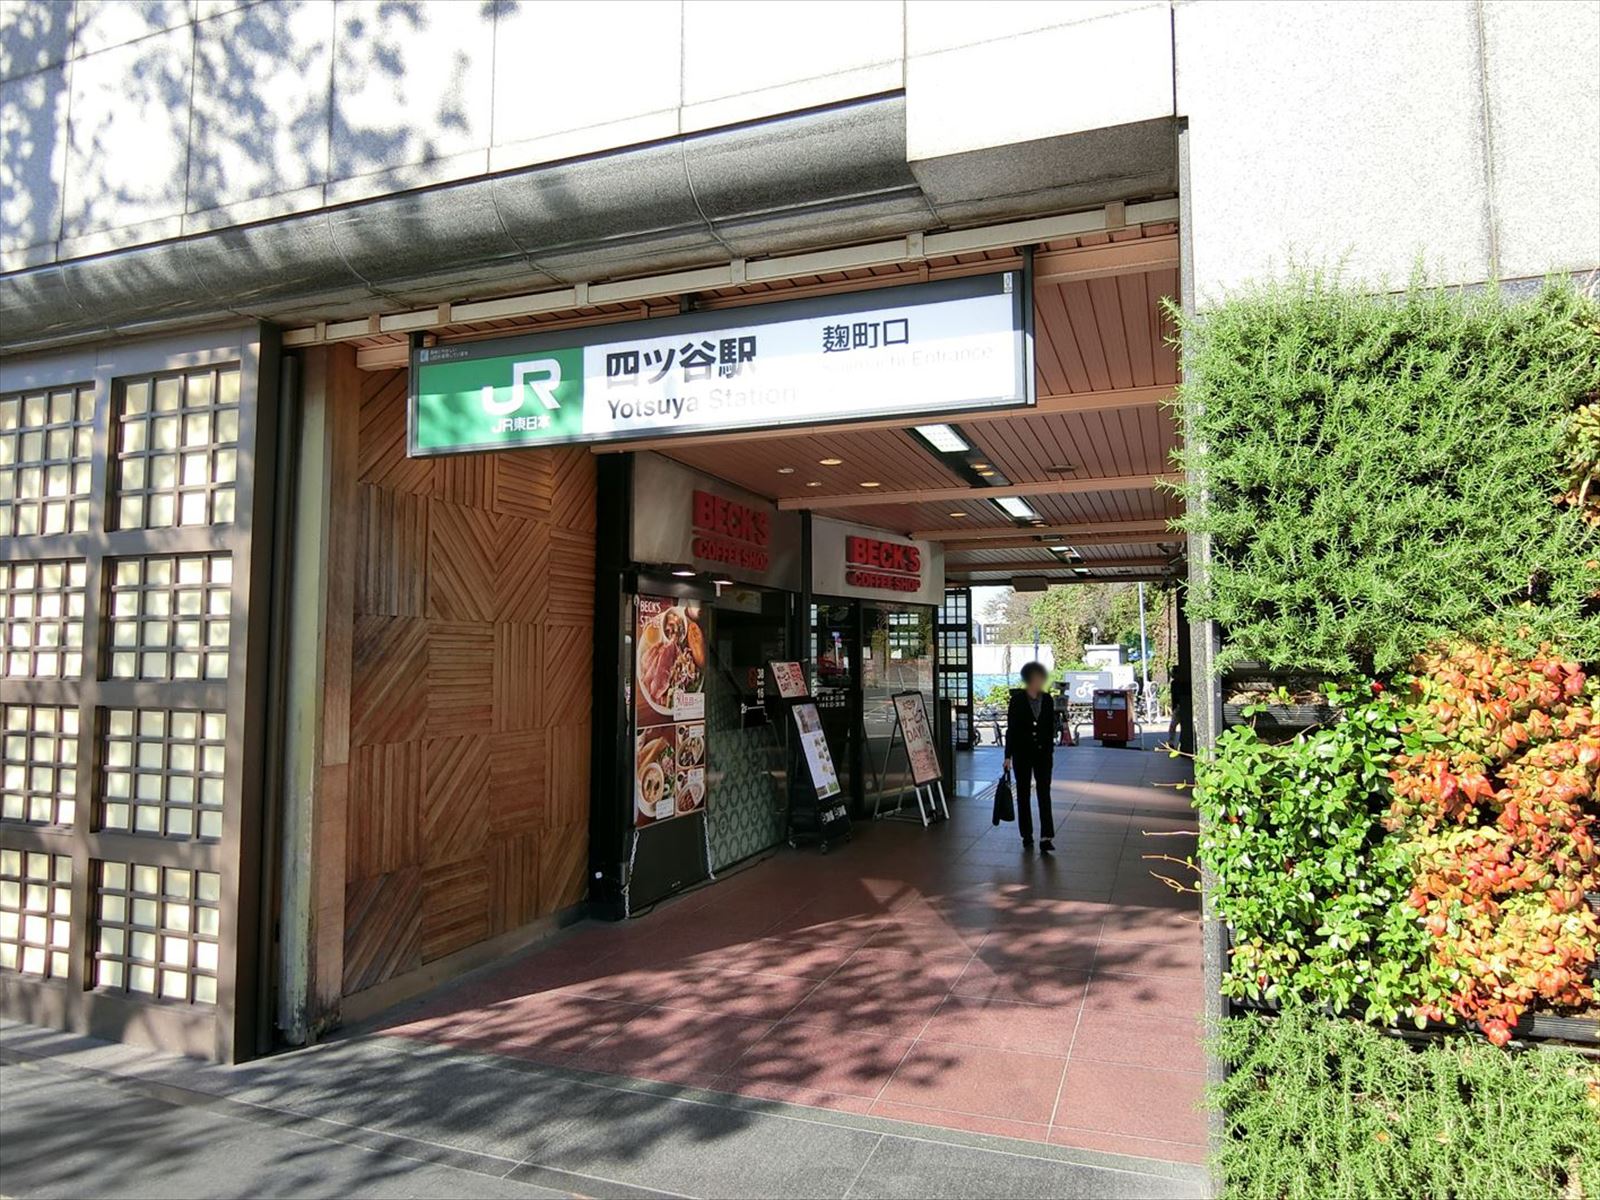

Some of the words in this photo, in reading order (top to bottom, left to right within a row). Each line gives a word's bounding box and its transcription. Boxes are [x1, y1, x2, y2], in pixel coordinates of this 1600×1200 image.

[606, 335, 757, 389] 四ツ谷駅
[480, 358, 562, 416] JR
[607, 396, 699, 420] Yotsuya
[708, 384, 799, 410] Station
[491, 415, 552, 434] JR東日本
[692, 490, 769, 546] BECK'S
[692, 537, 739, 565] COFFEE
[740, 548, 769, 572] SHOP
[846, 535, 921, 573] BECK'S
[846, 571, 894, 591] COFFEE
[895, 576, 921, 593] SHOP
